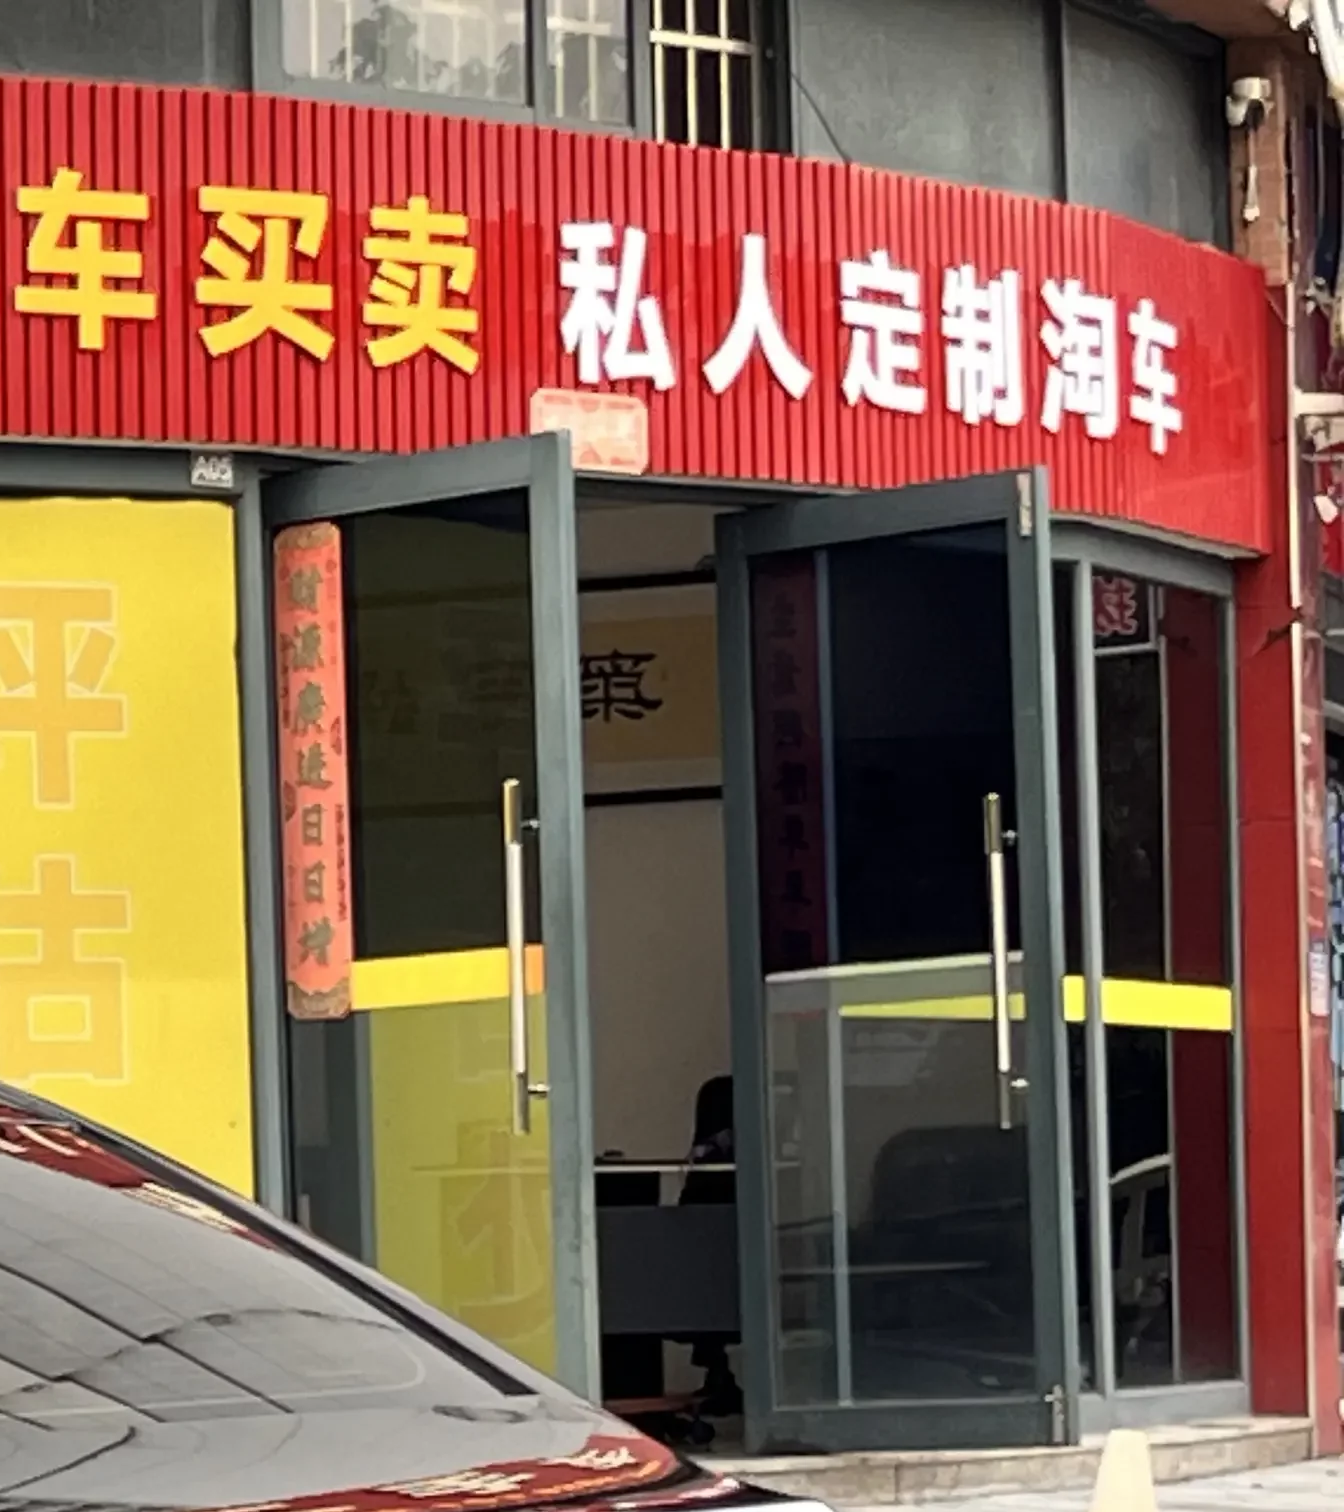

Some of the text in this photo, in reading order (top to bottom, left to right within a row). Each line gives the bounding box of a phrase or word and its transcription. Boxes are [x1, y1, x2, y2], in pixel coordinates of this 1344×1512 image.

[560, 220, 1182, 454] 私人定制淘车
